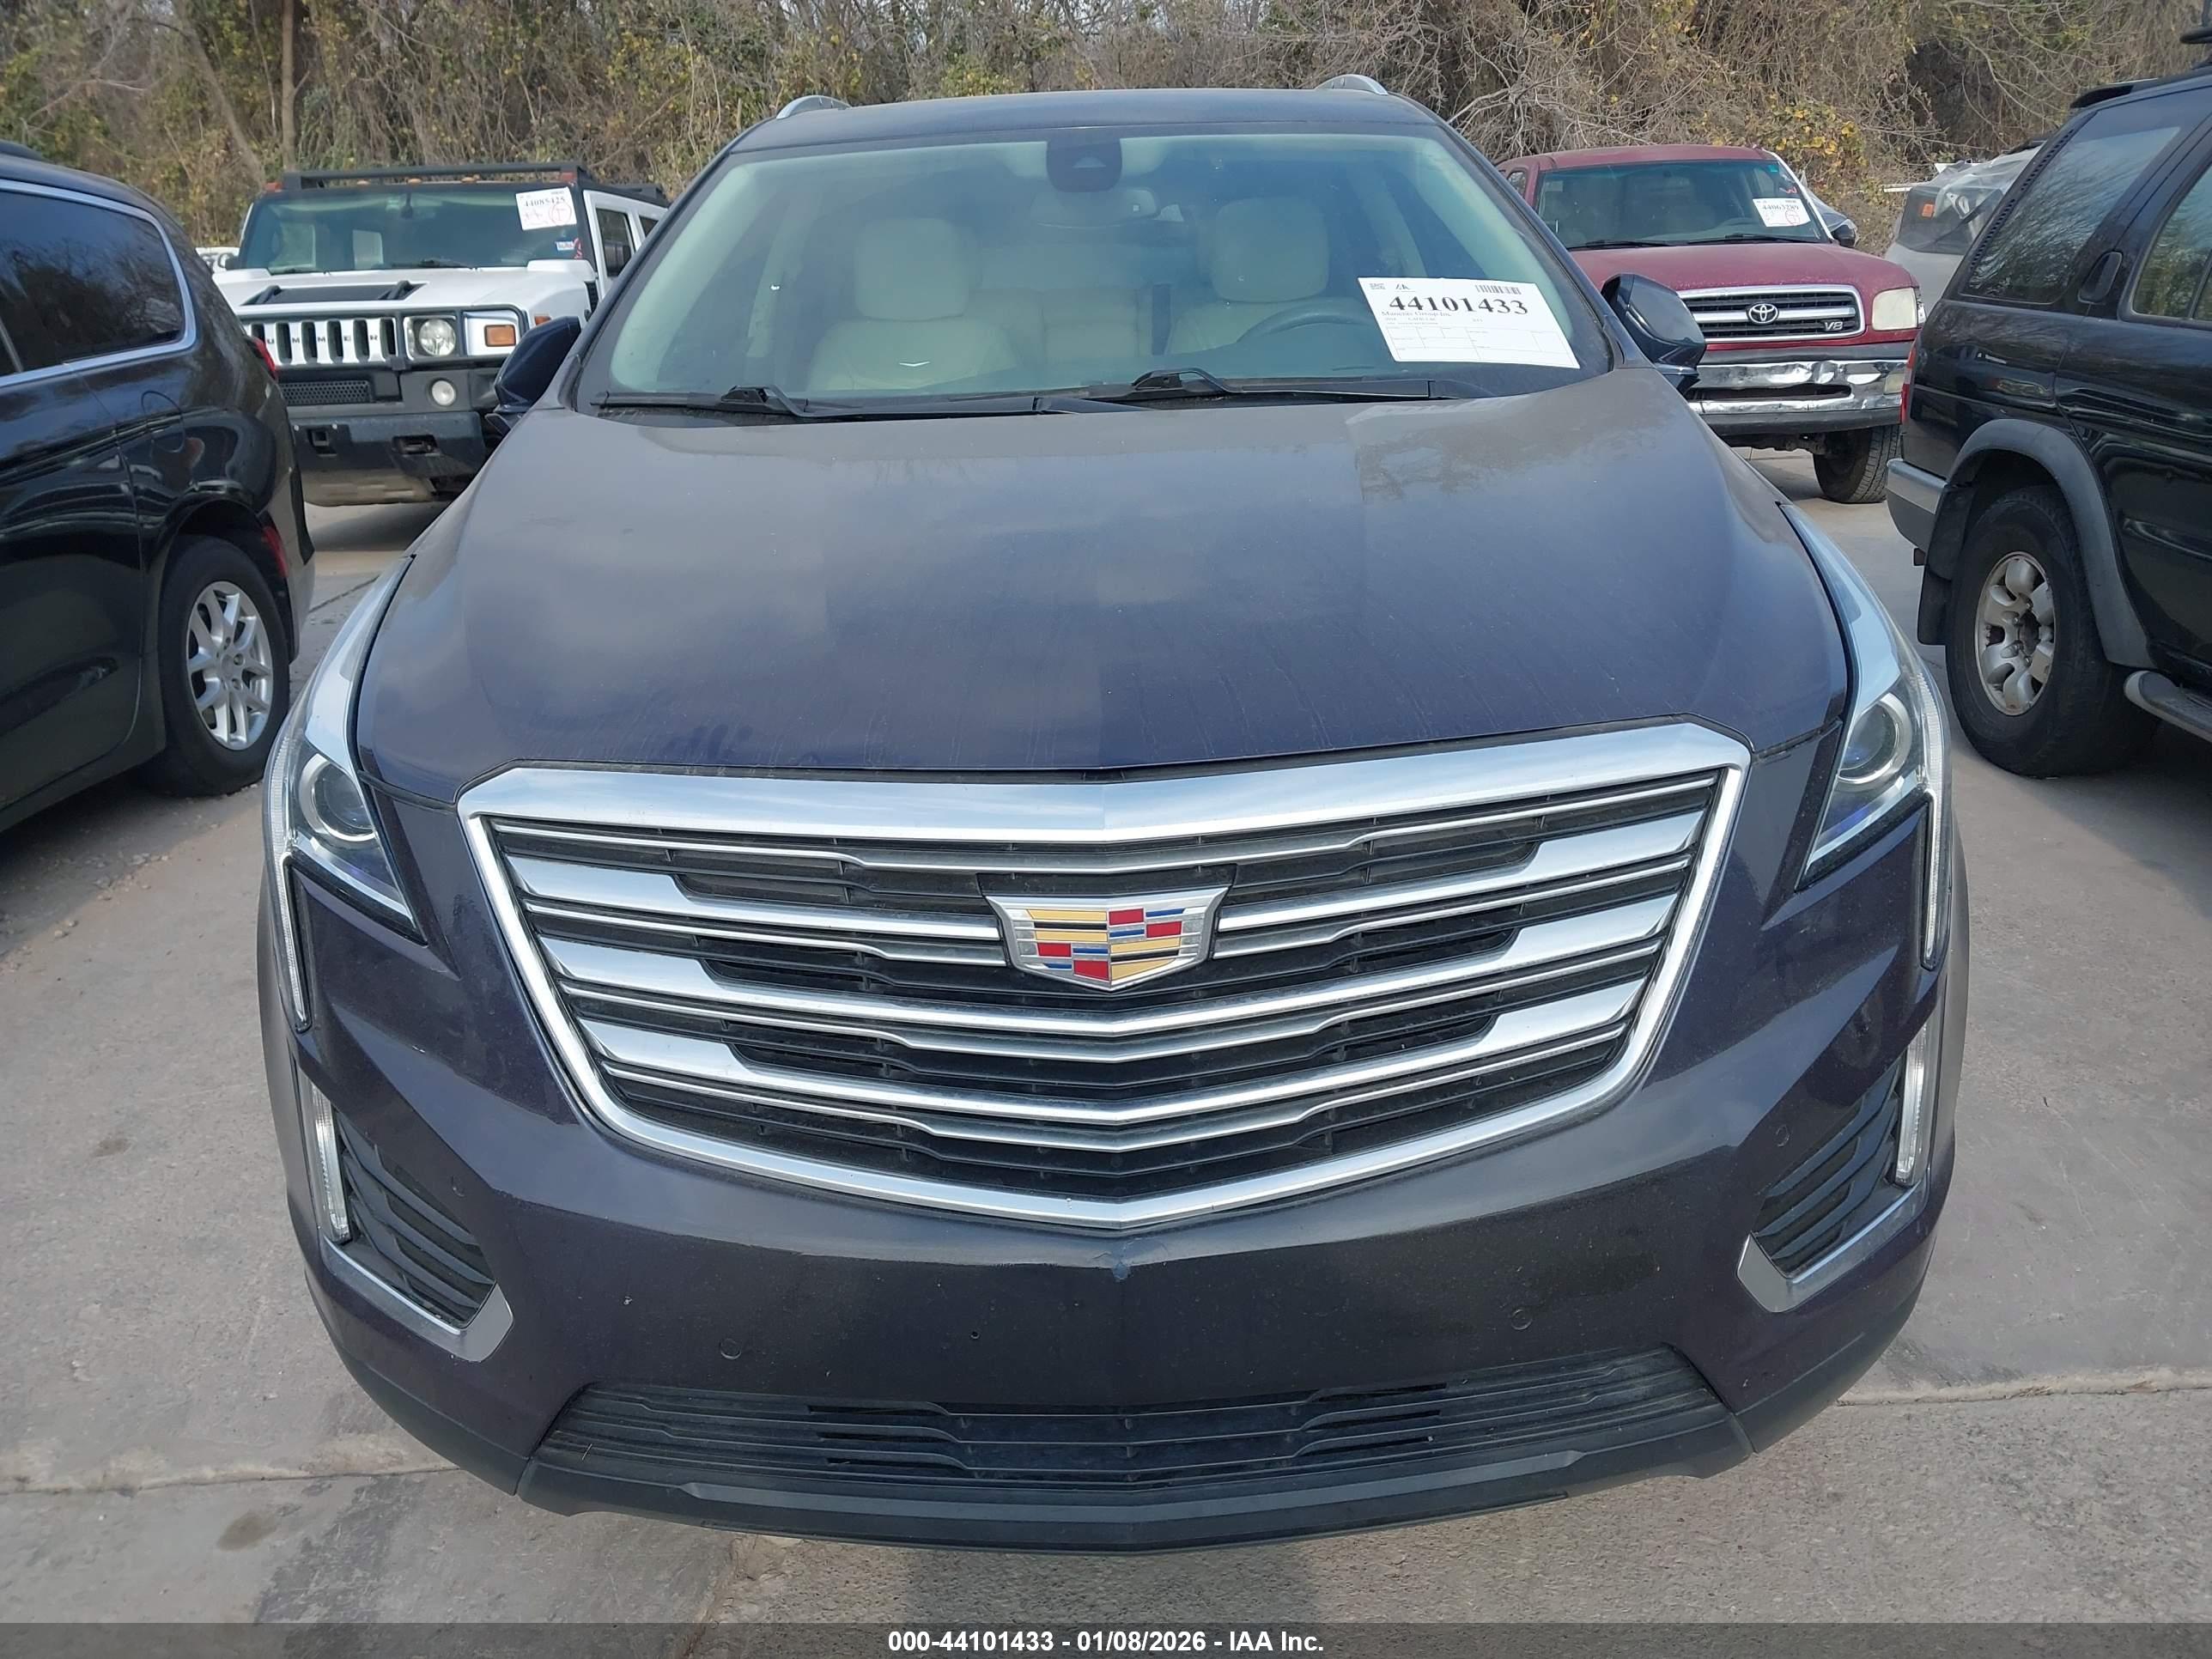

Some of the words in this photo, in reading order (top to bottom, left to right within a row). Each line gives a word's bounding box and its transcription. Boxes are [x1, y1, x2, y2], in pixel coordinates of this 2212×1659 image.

[1389, 296, 1528, 315] 44101433
[1824, 321, 1844, 331] V8
[267, 334, 378, 344] UMMER
